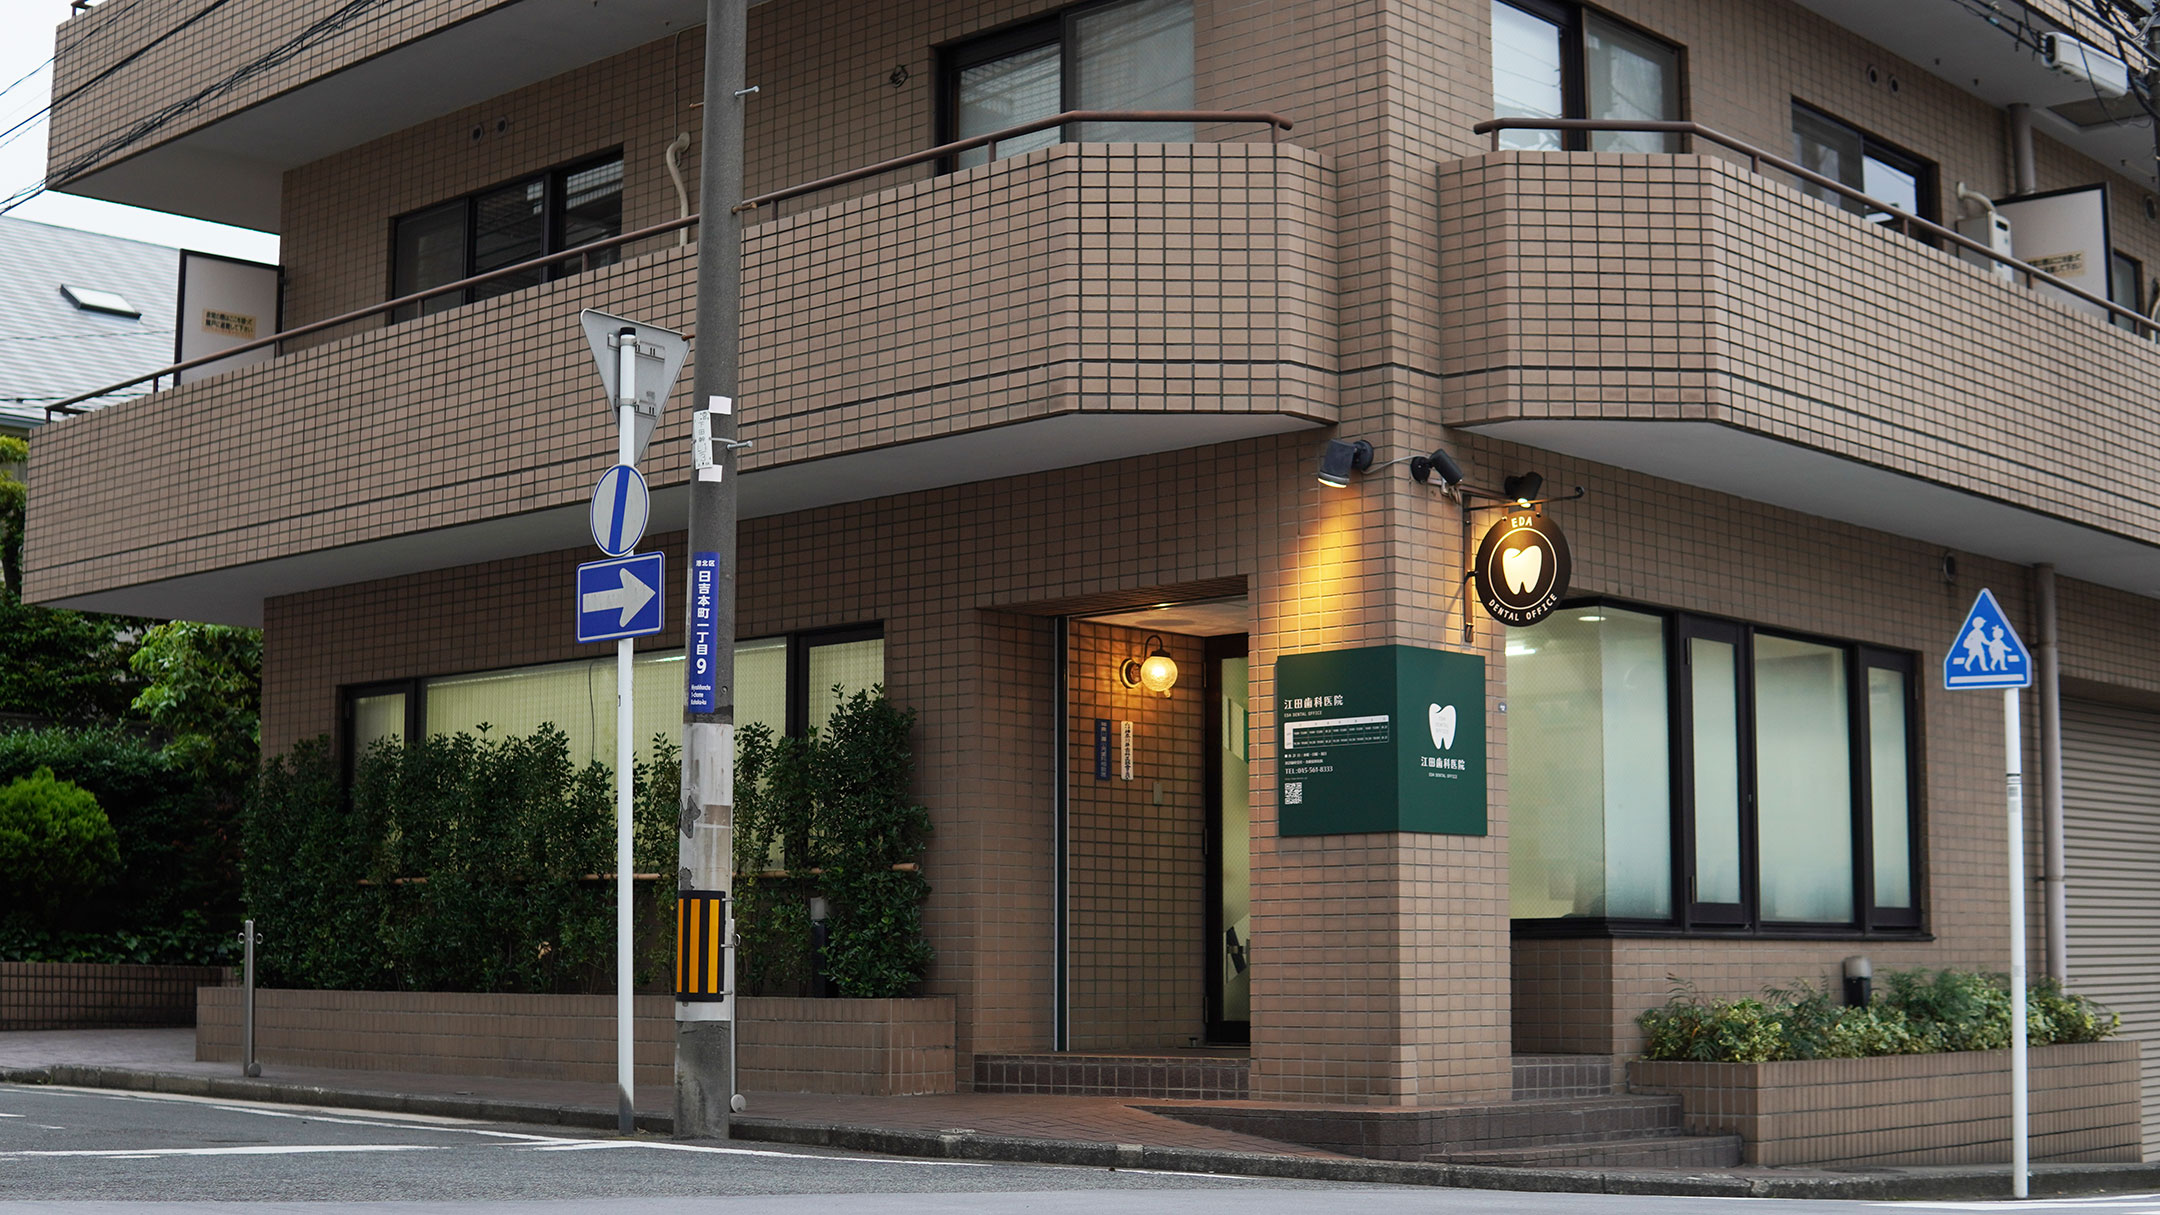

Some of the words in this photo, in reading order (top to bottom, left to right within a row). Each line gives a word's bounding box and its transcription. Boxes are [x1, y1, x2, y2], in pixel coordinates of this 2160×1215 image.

[1511, 516, 1533, 528] EDA
[1488, 599, 1520, 621] DENTAL
[1525, 593, 1558, 620] OFFICE
[1284, 695, 1343, 710] 江田歯科医院
[1421, 756, 1465, 771] 江田歯科医院
